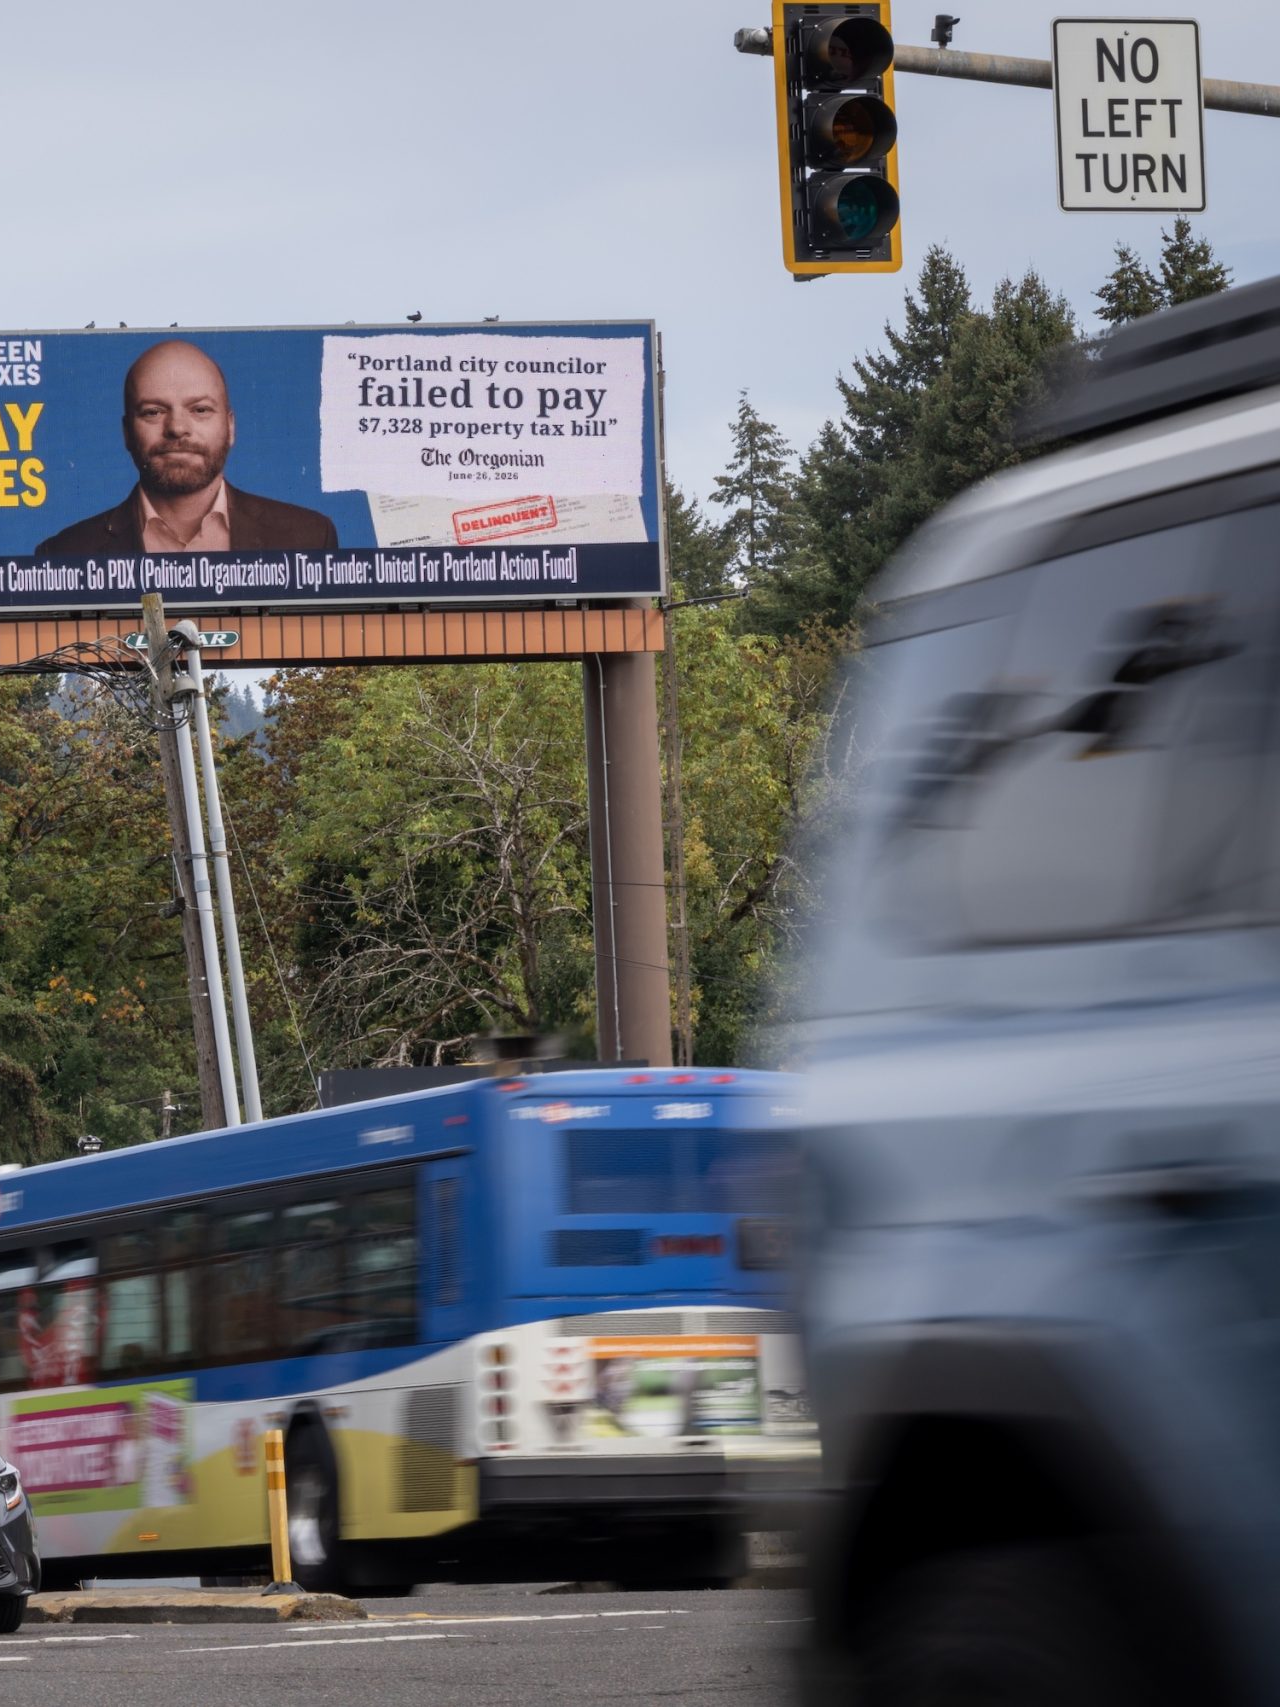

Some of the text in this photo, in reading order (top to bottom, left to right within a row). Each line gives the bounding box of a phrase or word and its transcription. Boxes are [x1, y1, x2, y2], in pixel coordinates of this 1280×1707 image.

[1096, 37, 1159, 84] NO
[1081, 98, 1183, 138] LEFT
[1075, 153, 1187, 193] TURN
[459, 355, 498, 377] city
[504, 357, 607, 375] councilor
[357, 376, 607, 418] failed to pay
[358, 417, 423, 436] $7,328
[429, 420, 523, 440] property
[530, 420, 565, 437] tax
[420, 448, 545, 470] The Oregonian
[447, 471, 519, 482] June 26, 2026
[460, 506, 550, 534] DELINQUENT
[7, 560, 84, 592] Contributor:
[87, 559, 104, 590] Go
[108, 559, 136, 590] PDX
[139, 556, 196, 592] (Political
[200, 553, 290, 594] Organizations)
[295, 553, 322, 592] [Top
[326, 553, 372, 586] Funder:
[375, 552, 416, 584] United
[419, 552, 439, 583] For
[443, 551, 496, 582] Portland
[500, 550, 539, 581] Action
[543, 547, 578, 583] Fund]
